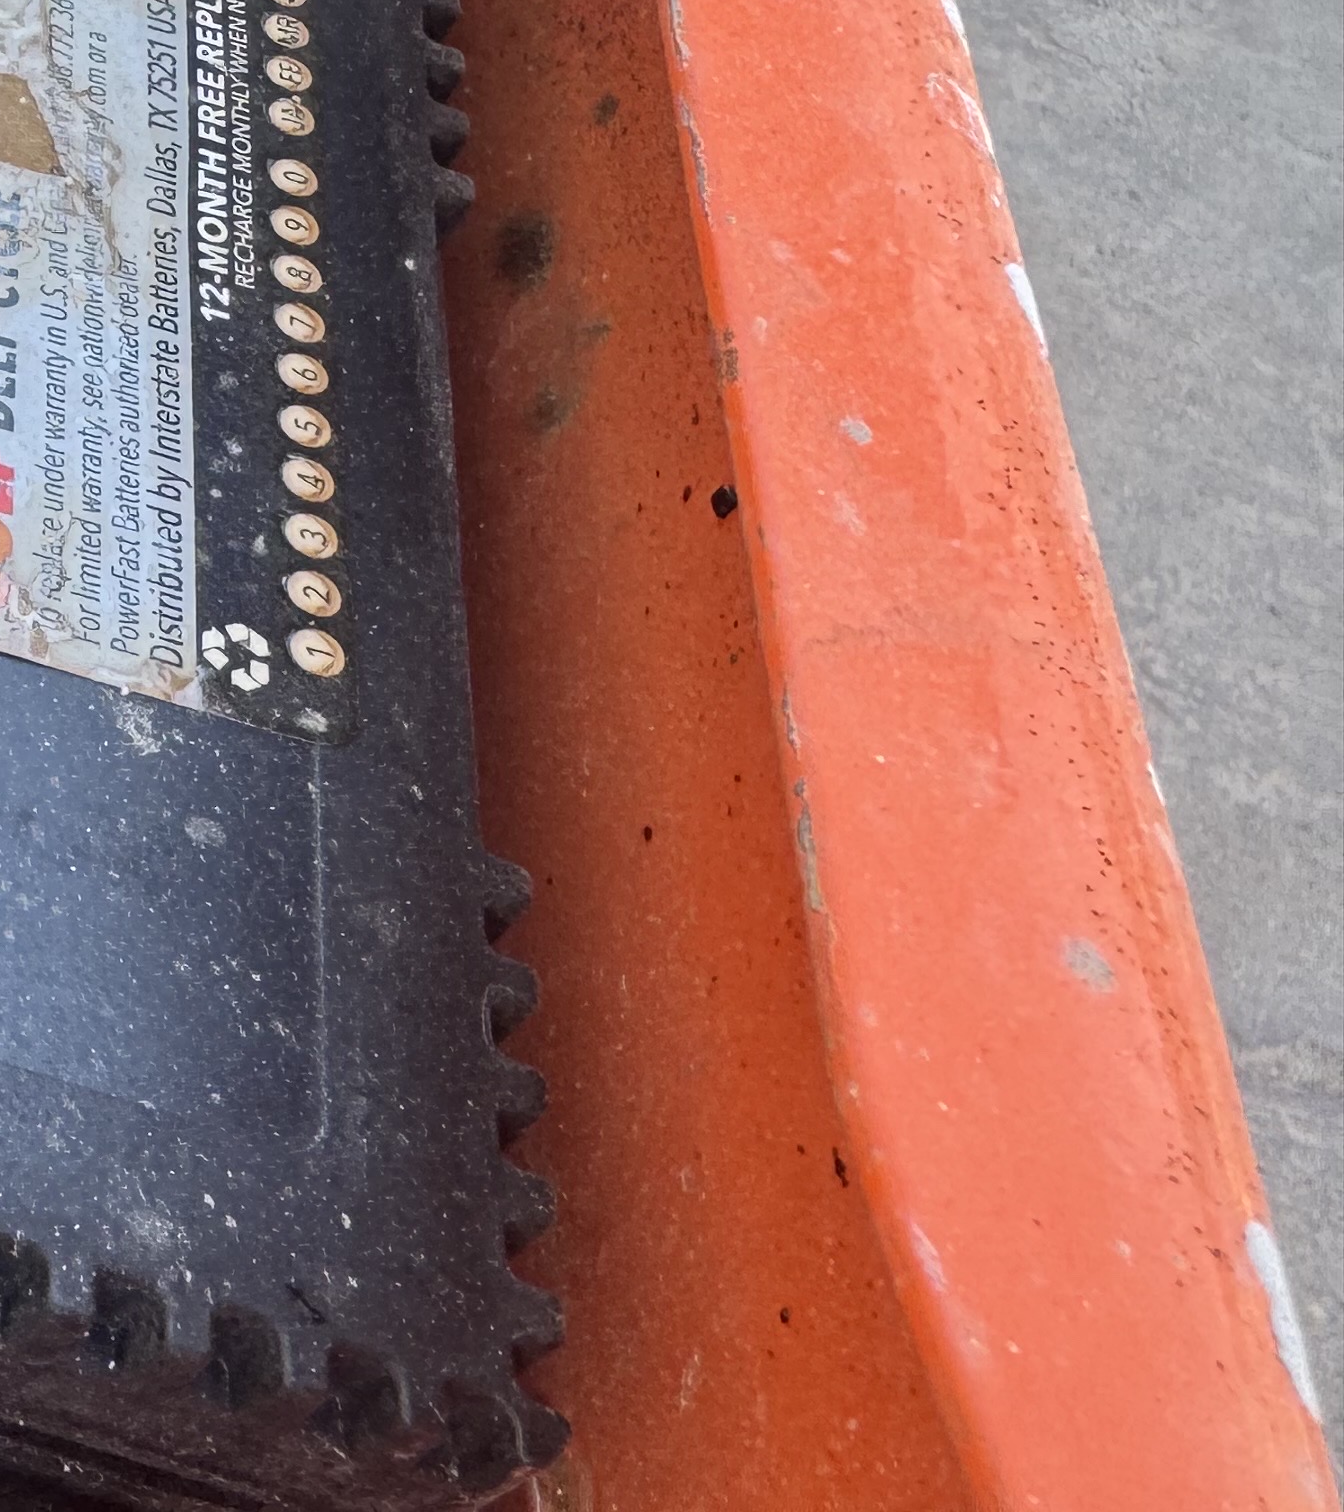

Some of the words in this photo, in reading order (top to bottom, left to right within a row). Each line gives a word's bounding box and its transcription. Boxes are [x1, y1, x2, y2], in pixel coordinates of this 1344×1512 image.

[88, 31, 108, 42] a
[88, 46, 107, 64] or
[226, 16, 250, 74] WHEN
[146, 39, 179, 103] 75251
[147, 98, 178, 132] TX
[196, 68, 228, 144] FREE
[229, 75, 253, 174] MONTHLY
[144, 142, 182, 218] Dallas,
[282, 170, 310, 184] 0
[196, 146, 231, 322] 12-MONTH
[231, 175, 256, 289] RECHARGE
[284, 217, 309, 231] 9
[40, 238, 68, 278] and
[107, 254, 139, 317] dealer.
[146, 226, 181, 335] Batteries,
[286, 265, 312, 282] 8
[43, 326, 67, 347] in
[289, 315, 314, 328] 7
[42, 350, 75, 439] warranty
[82, 373, 105, 410] see
[109, 319, 140, 433] authorized
[149, 340, 183, 463] Interstate
[291, 367, 319, 382] 6
[294, 417, 322, 436] 5
[34, 442, 64, 512] under
[77, 416, 111, 513] warranty,
[109, 438, 141, 533] Batteries
[146, 466, 193, 501] by
[296, 472, 325, 494] 4
[70, 518, 102, 603] limited
[146, 503, 184, 669] Distributed
[110, 535, 140, 656] PowerFast
[303, 585, 331, 604] 2
[72, 604, 101, 647] For
[305, 645, 336, 658] 1
